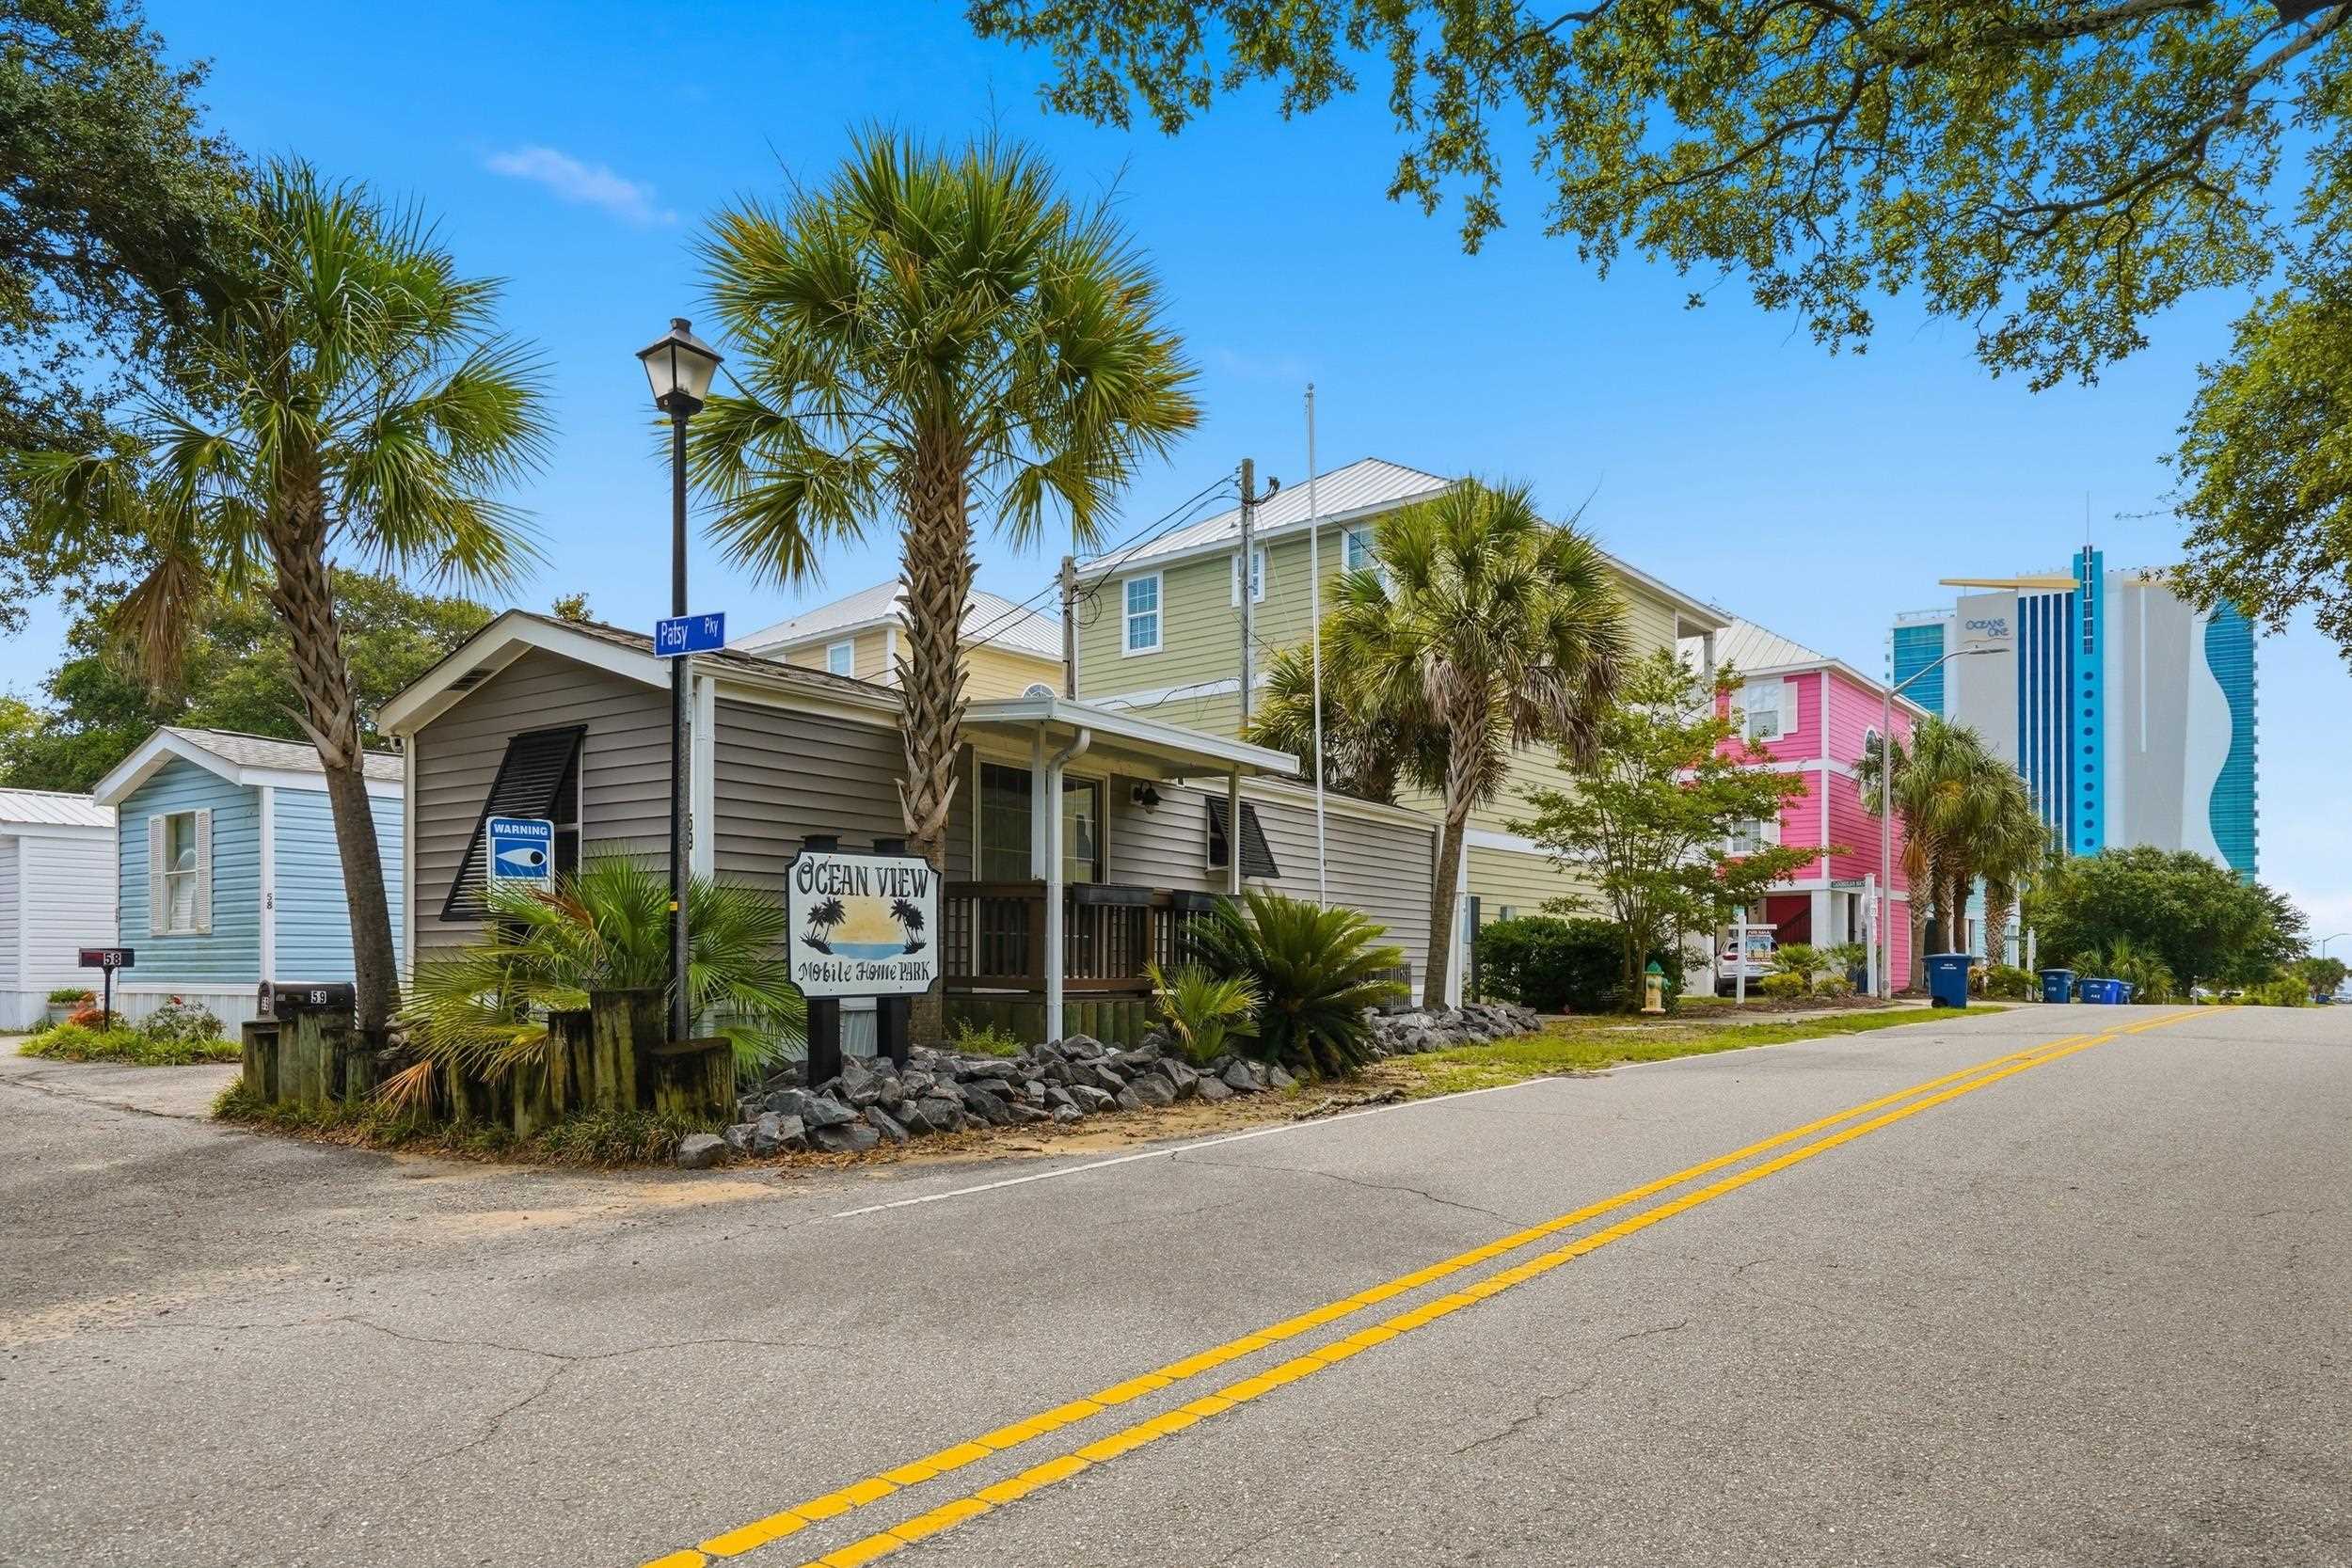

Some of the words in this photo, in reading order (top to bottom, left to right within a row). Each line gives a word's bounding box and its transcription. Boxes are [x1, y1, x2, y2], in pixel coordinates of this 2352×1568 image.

[1965, 618, 2006, 630] OCEANS
[660, 621, 689, 651] Patsy
[493, 823, 548, 836] WARNING
[796, 855, 870, 896] OCEAN
[874, 866, 930, 898] VIEW
[104, 953, 120, 965] 58
[798, 961, 852, 983] Mobile
[855, 961, 898, 981] Home
[898, 961, 930, 981] PARK
[311, 991, 326, 1004] 59
